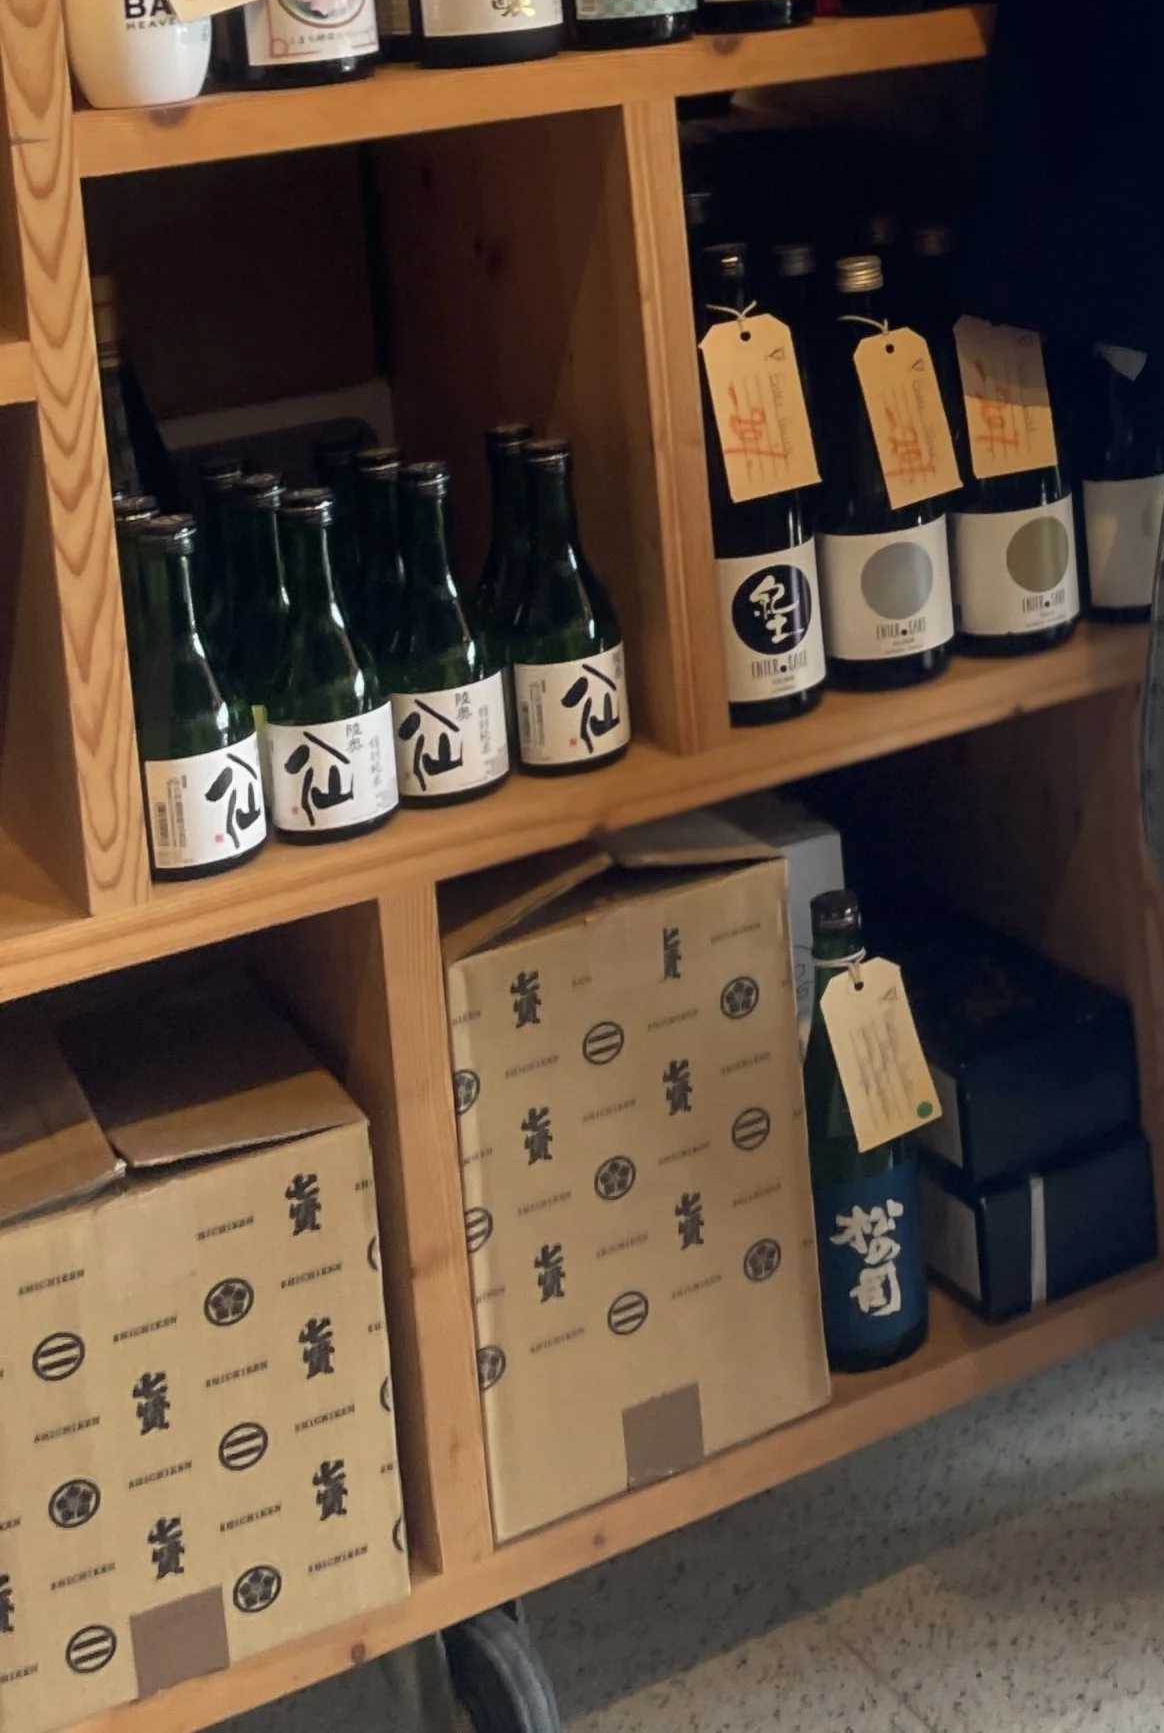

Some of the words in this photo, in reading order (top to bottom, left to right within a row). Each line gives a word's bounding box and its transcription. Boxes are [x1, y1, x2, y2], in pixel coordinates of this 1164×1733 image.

[510, 971, 541, 1029] 七賢
[663, 1059, 692, 1116] 七賢
[521, 1107, 553, 1165] 七賢
[285, 1174, 321, 1236] 七賢
[675, 1193, 704, 1250] 七賢
[18, 1269, 85, 1296] SHICHIKEN
[281, 1262, 342, 1289] SHICHIKEN
[534, 1244, 565, 1303] 七賢
[829, 1199, 904, 1317] 松の司
[113, 1316, 177, 1343] SHICHIKEN
[299, 1318, 335, 1380] 七賢
[205, 1360, 268, 1388] SHICHIKEN
[34, 1416, 100, 1444] SHICHIKEN
[132, 1372, 170, 1435] 七賢
[295, 1404, 355, 1433] SHICHIKEN
[129, 1460, 192, 1490] SHICHIKEN
[312, 1460, 348, 1521] 七賢
[220, 1504, 281, 1532] SHICHIKEN
[50, 1562, 115, 1592] SHICHIKEN
[147, 1517, 185, 1580] 七賢
[308, 1544, 368, 1574] SHICHIKEN
